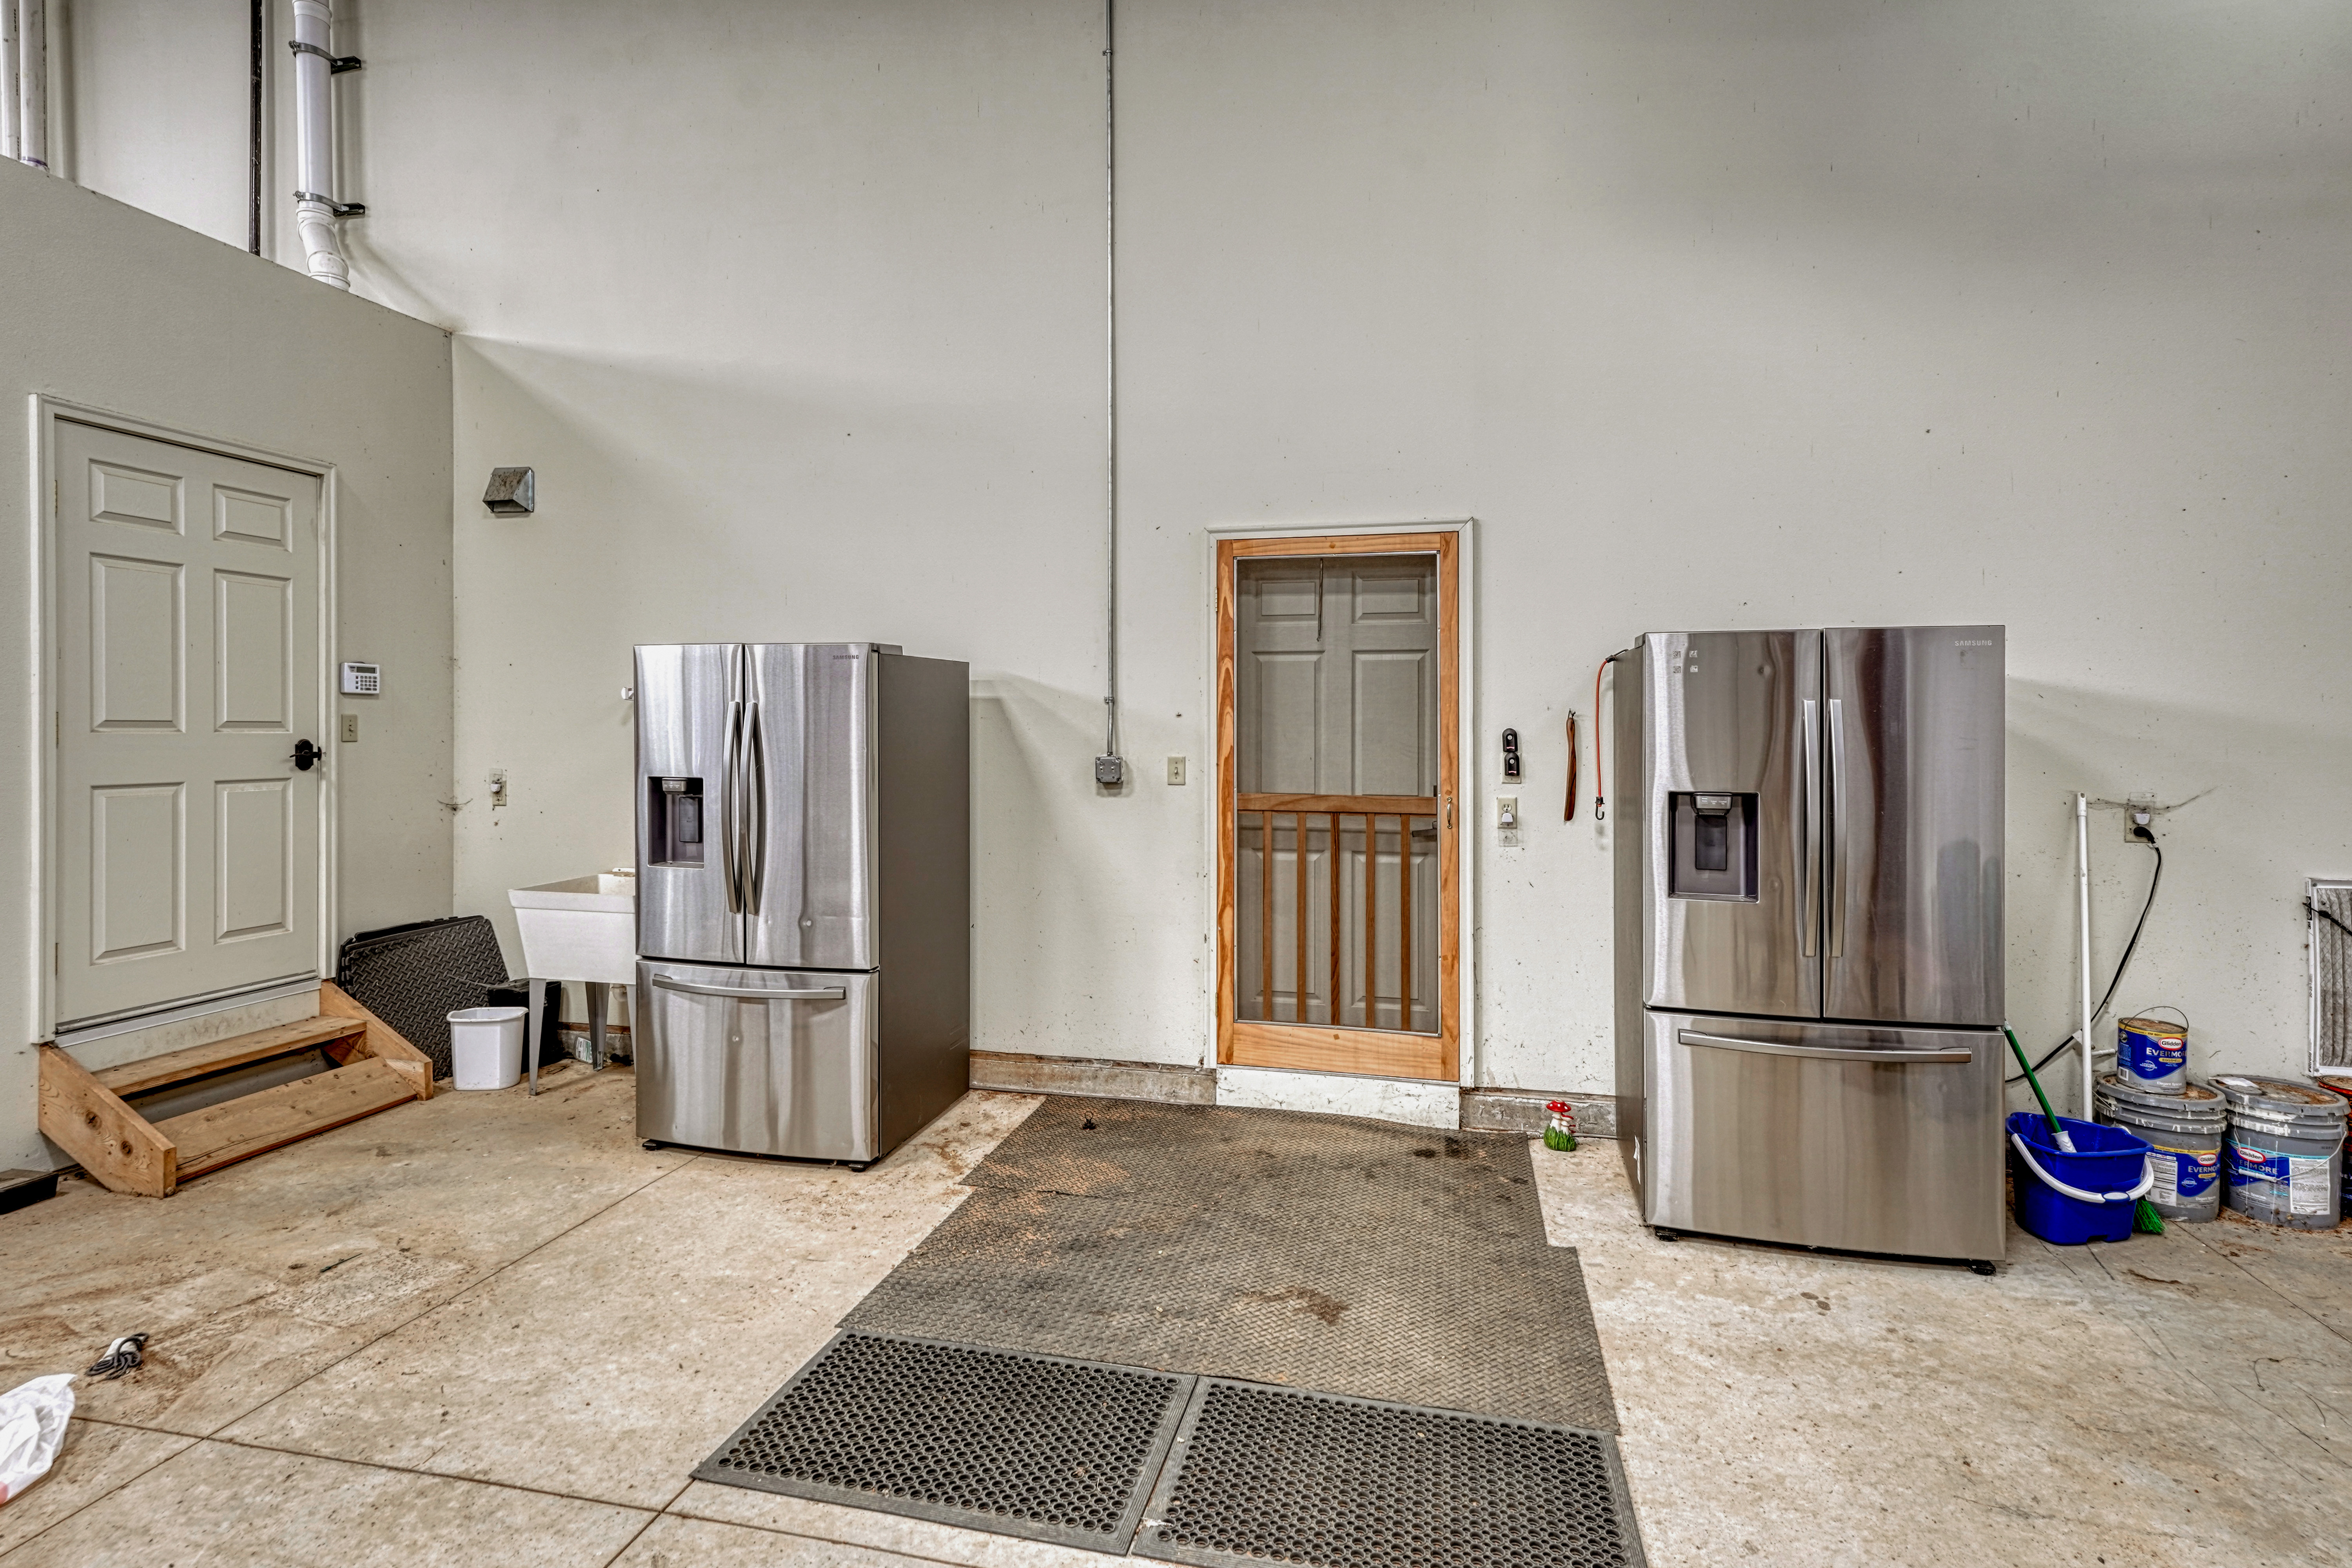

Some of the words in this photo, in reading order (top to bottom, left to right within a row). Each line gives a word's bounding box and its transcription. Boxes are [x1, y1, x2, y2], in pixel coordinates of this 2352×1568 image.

[2146, 1047, 2187, 1057] EVERMORE
[2239, 1150, 2262, 1160] Glidden
[2239, 1160, 2278, 1175] ERMORE
